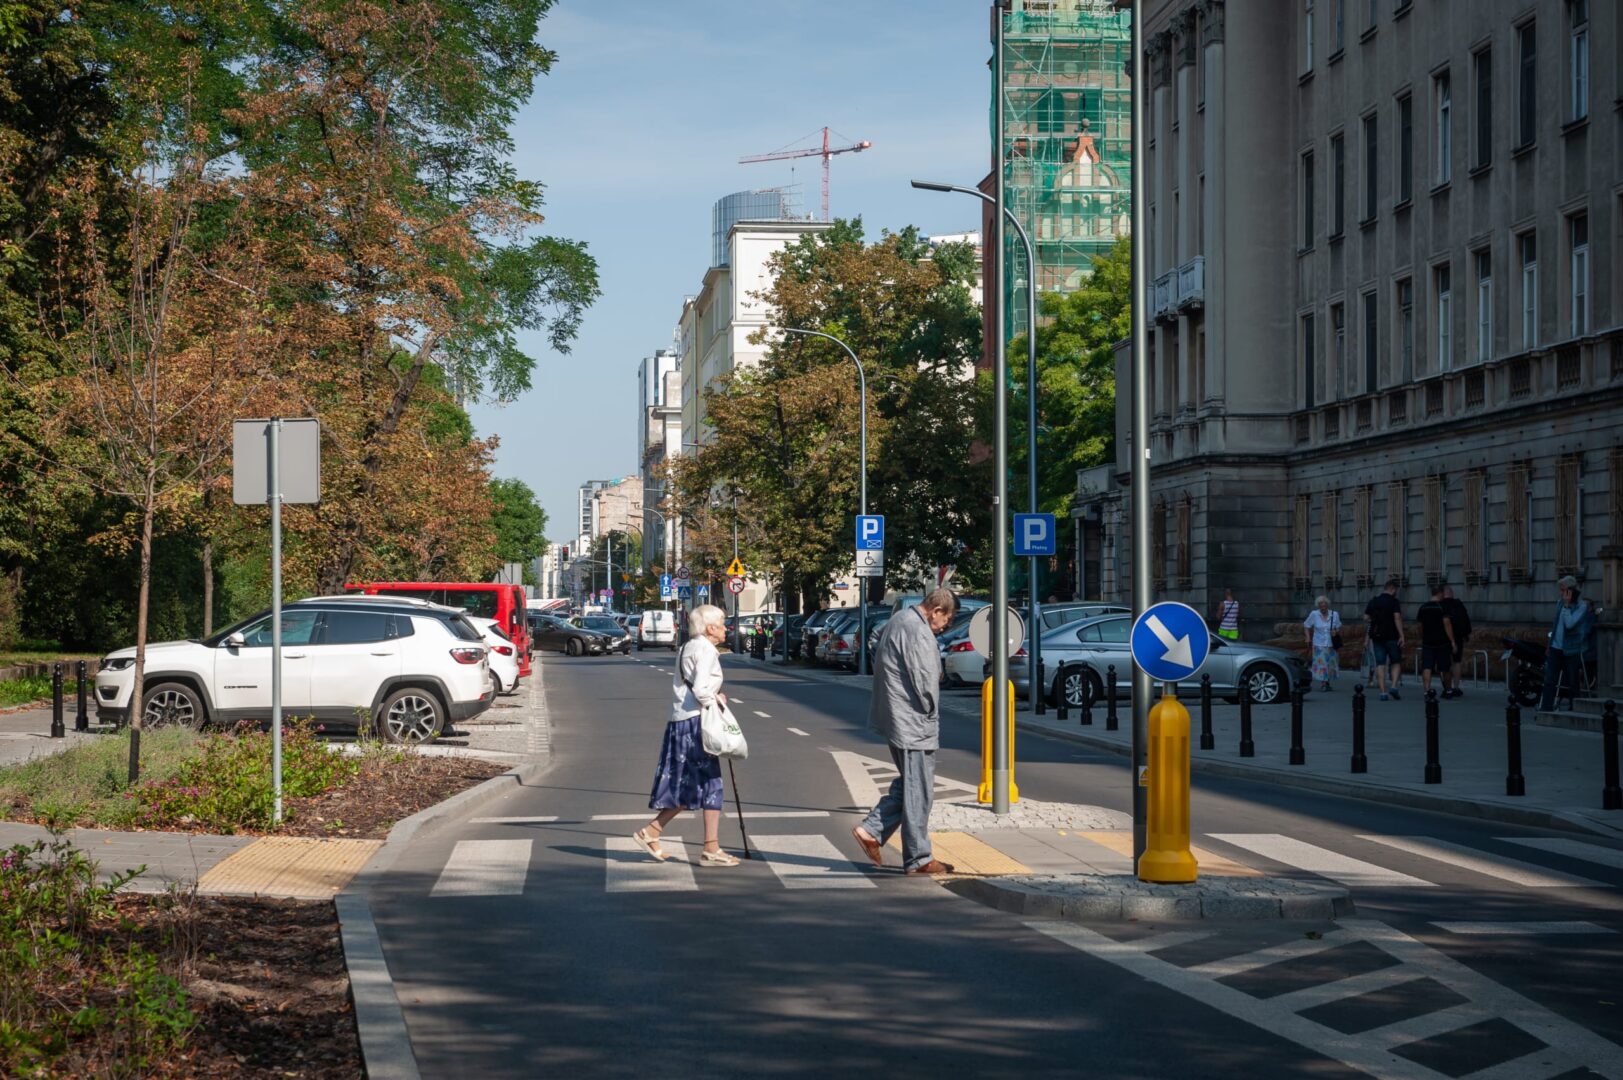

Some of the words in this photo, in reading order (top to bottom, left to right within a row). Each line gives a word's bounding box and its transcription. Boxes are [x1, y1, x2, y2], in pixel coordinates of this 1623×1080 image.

[863, 518, 878, 540] P
[1024, 518, 1047, 550] P
[663, 586, 670, 595] P
